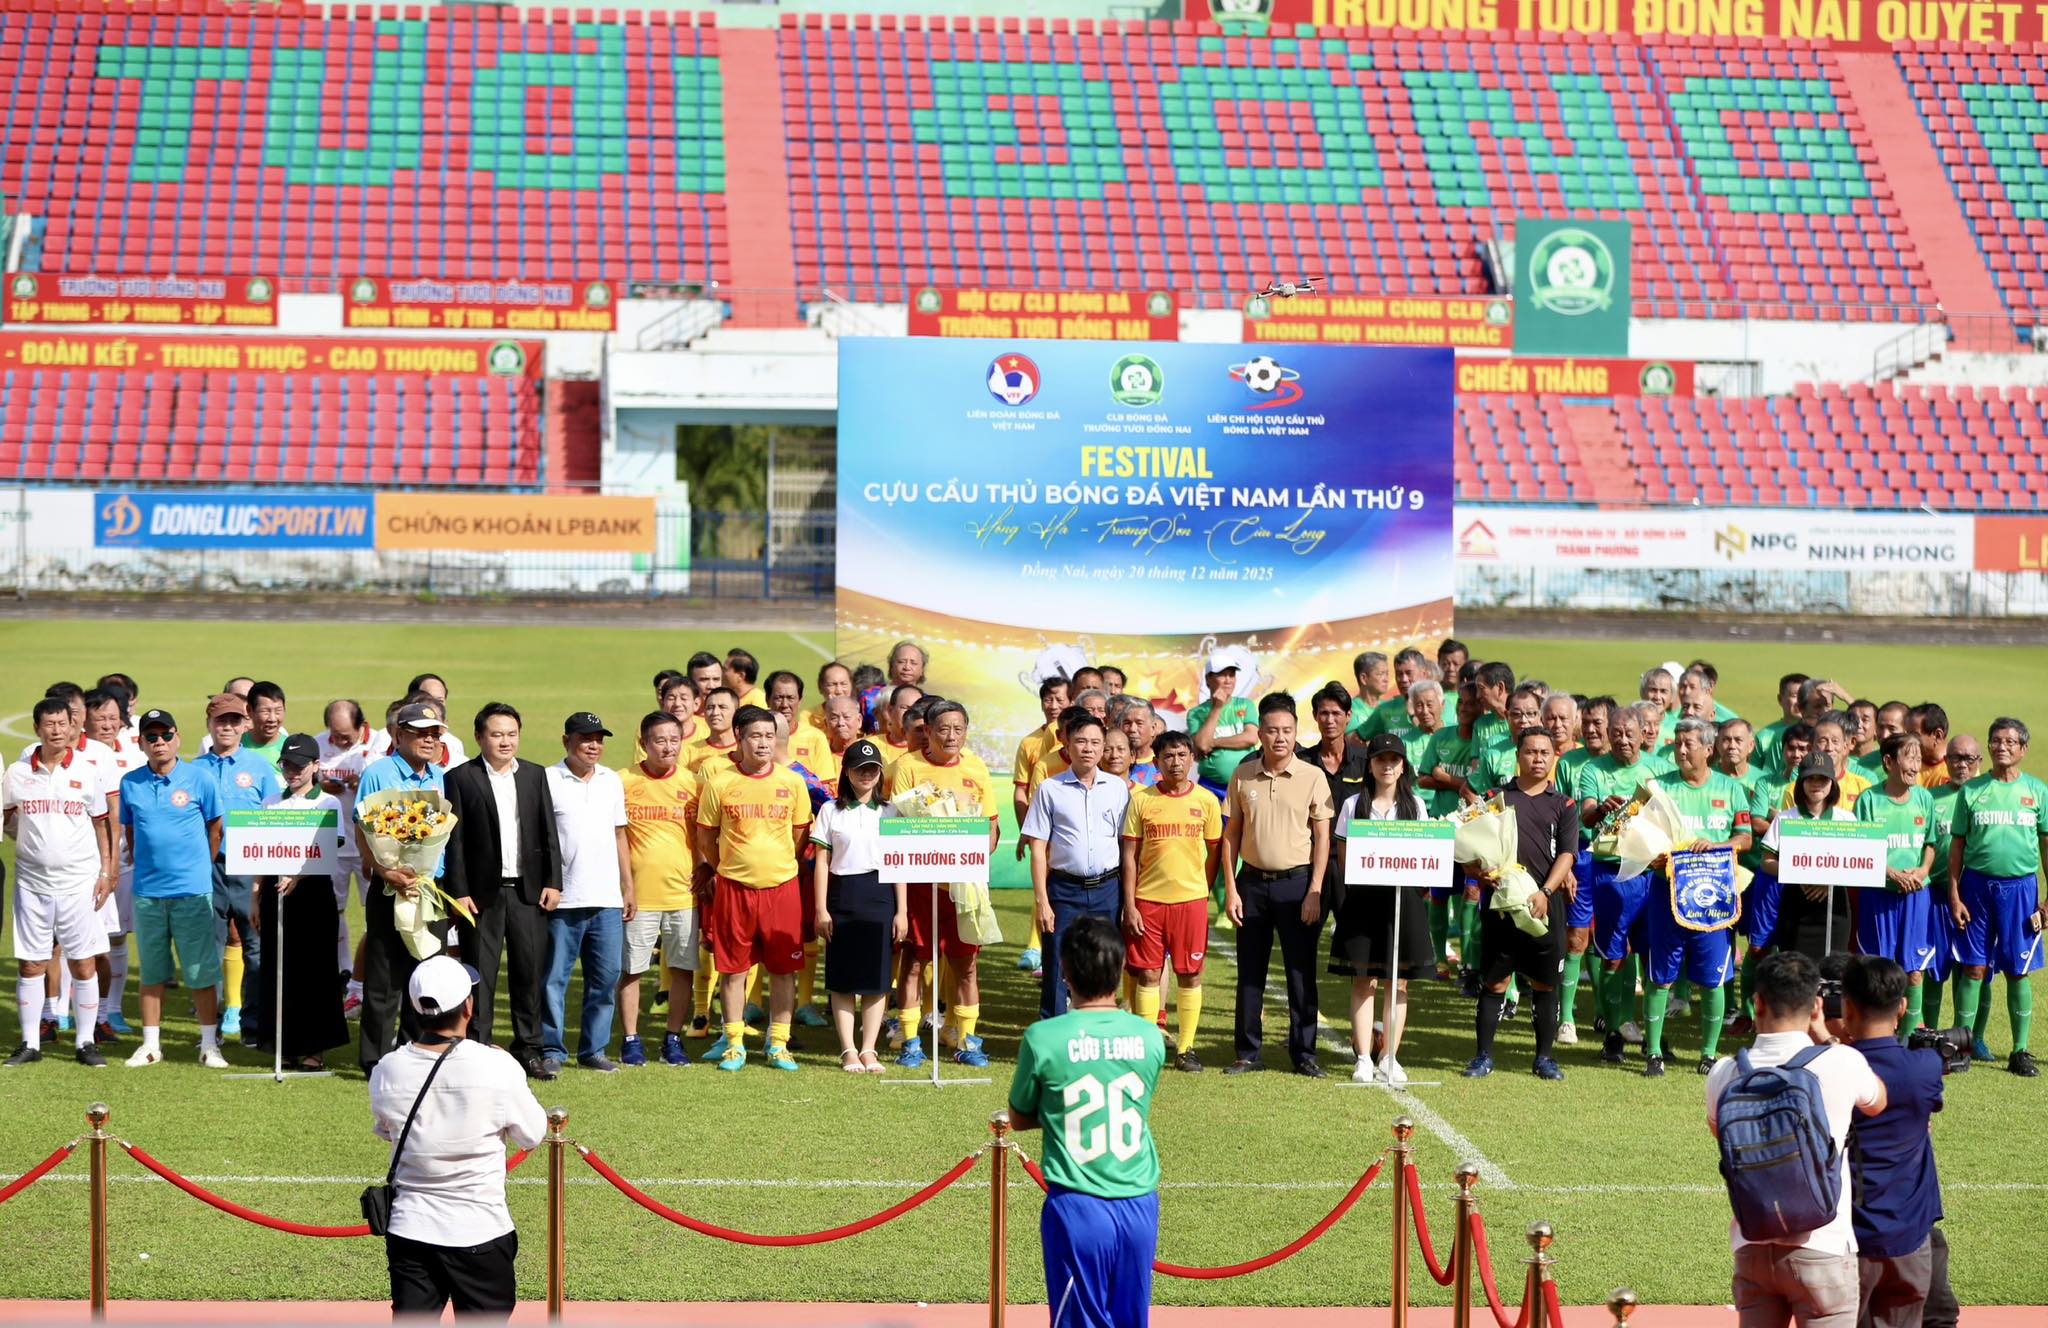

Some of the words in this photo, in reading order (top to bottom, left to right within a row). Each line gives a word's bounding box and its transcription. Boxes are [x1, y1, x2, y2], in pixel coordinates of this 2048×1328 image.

[1780, 0, 1860, 41] NAI
[43, 303, 90, 321] TRUNG
[135, 304, 181, 322] TRUNG
[225, 306, 272, 324] TRUNG
[1448, 300, 1483, 320] CLB
[1116, 320, 1149, 340] NAI
[1255, 323, 1318, 340] TRONG
[21, 337, 88, 365] ĐOÀN
[95, 335, 138, 366] KẾT
[161, 346, 239, 368] TRUNG
[246, 346, 307, 372] THỰC
[329, 347, 377, 370] CAO
[384, 346, 478, 375] THƯỢNG
[1459, 359, 1529, 392] CHIẾN
[1534, 358, 1608, 394] THẮNG
[1014, 423, 1035, 431] NAM
[1106, 413, 1123, 422] CLB
[1207, 413, 1227, 423] LIÊN
[1229, 415, 1244, 424] CHI
[1247, 413, 1263, 425] HỘI
[1265, 415, 1284, 426] CỰU
[1175, 426, 1191, 434] NAI
[1223, 426, 1249, 434] BÓNG
[1251, 426, 1265, 435] ĐÁ
[1266, 426, 1286, 436] VIỆT
[1288, 427, 1309, 436] NAM
[1081, 445, 1213, 478] FESTIVAL
[863, 480, 924, 507] CỰU
[926, 477, 979, 504] CẦU
[986, 479, 1038, 505] THỦ
[1045, 480, 1119, 506] BÓNG
[1126, 482, 1163, 506] ĐÁ
[1170, 482, 1225, 511] VIỆT
[1231, 488, 1289, 508] NAM
[1297, 482, 1345, 509] LẦN
[1352, 485, 1405, 510] THỨ
[1408, 489, 1424, 510] 9
[151, 504, 367, 537] DONGLUCSPORT.VN
[387, 511, 468, 535] CHỨNG
[473, 511, 551, 535] KHOÁN
[557, 517, 642, 535] LPBANK
[1751, 533, 1797, 551] NPG
[1808, 544, 1864, 560] NINH
[1873, 544, 1955, 562] PHONG
[1128, 565, 1145, 579] 20
[1148, 565, 1187, 582] tháng
[1191, 566, 1205, 579] 12
[1210, 565, 1238, 580] năm
[1242, 566, 1274, 580] 2025
[23, 799, 61, 815] FESTIVAL
[628, 805, 668, 820] FESTIVAL
[724, 804, 765, 820] FESTIVAL
[768, 803, 789, 820] 2025
[1974, 810, 2015, 826] FESTIVAL
[243, 842, 263, 861] ĐỘI
[305, 842, 321, 858] HÀ
[883, 850, 904, 868] ĐỘI
[908, 849, 956, 865] TRƯỜNG
[960, 851, 985, 865] SƠN
[1792, 852, 1812, 870] ĐỘI
[1816, 851, 1839, 869] CỬU
[1843, 856, 1874, 870] LONG
[1361, 851, 1375, 869] TỔ
[1379, 856, 1417, 872] TRỌNG
[1421, 855, 1439, 870] TÀI
[1104, 1034, 1145, 1061] LONG
[1063, 1071, 1145, 1165] 26
